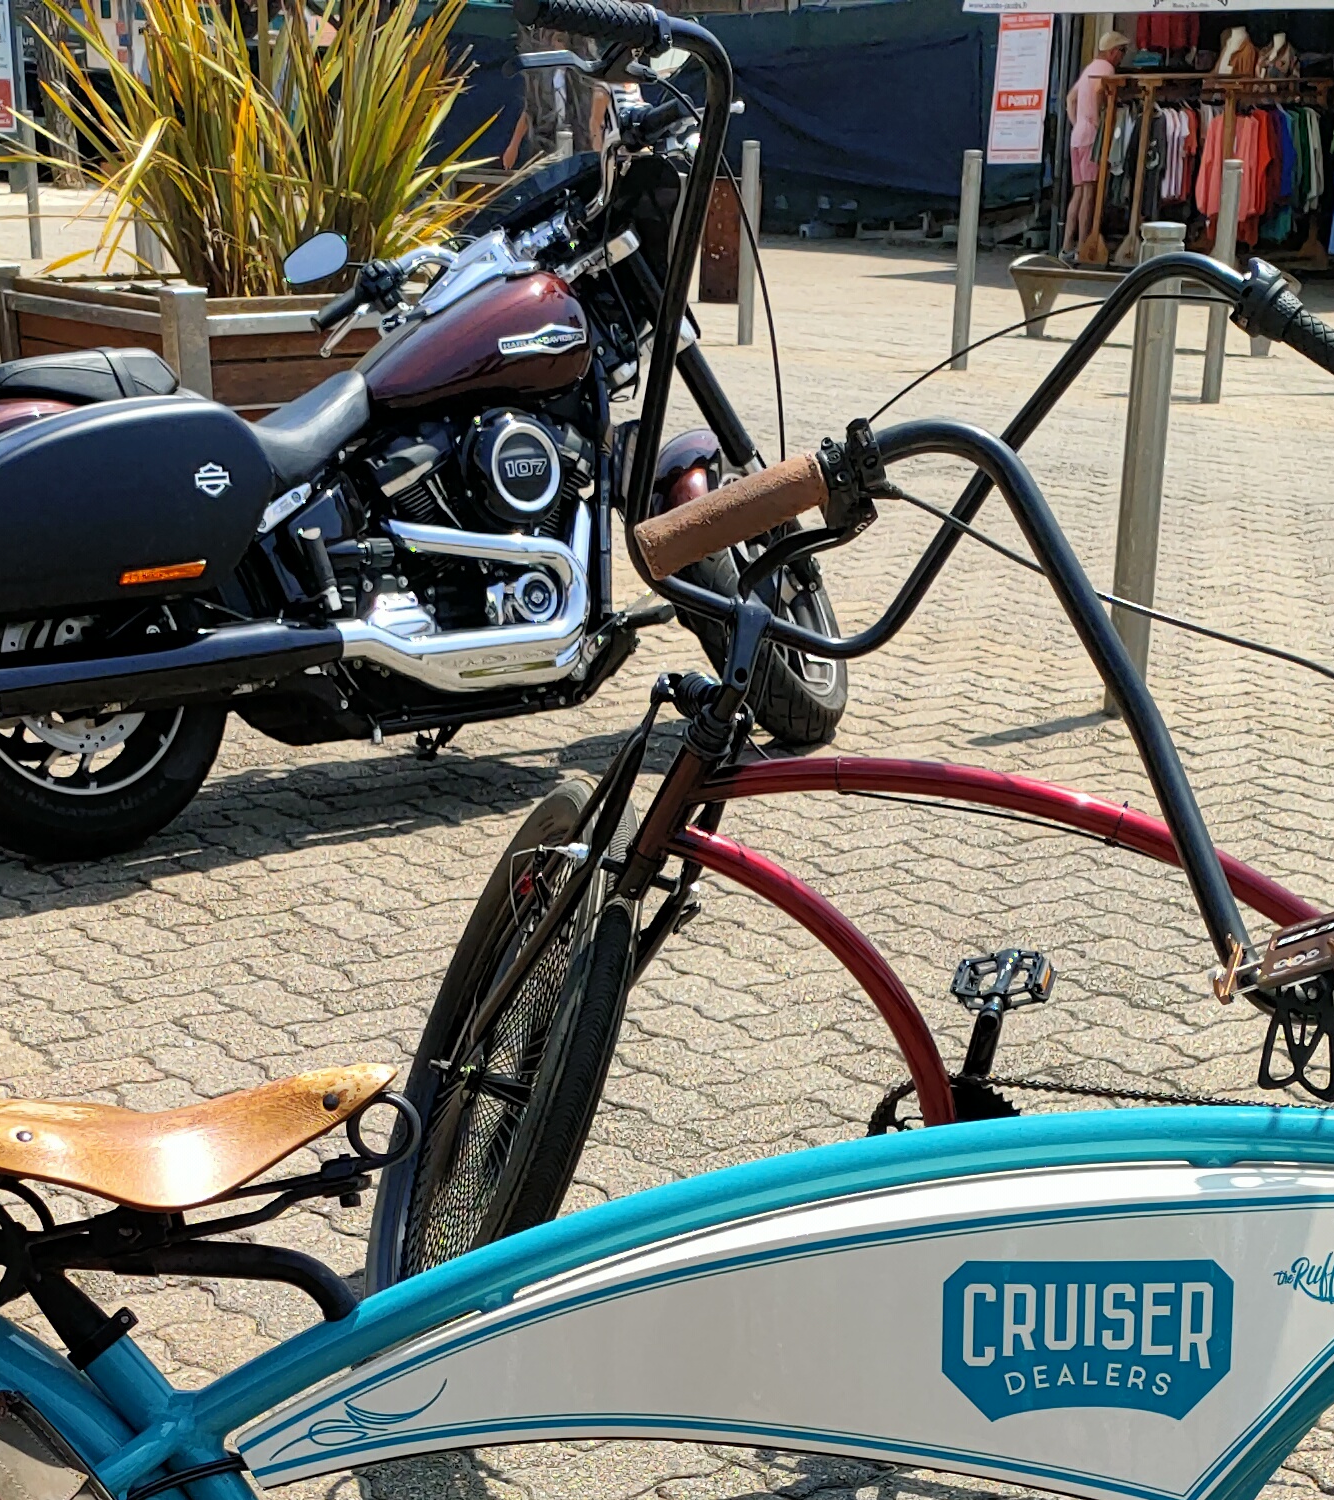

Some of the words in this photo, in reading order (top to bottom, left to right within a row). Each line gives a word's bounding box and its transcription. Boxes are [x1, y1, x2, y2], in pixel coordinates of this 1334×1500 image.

[502, 332, 585, 350] HARLEY-DAVIDSON
[505, 458, 547, 478] 107
[962, 1282, 1213, 1369] CRUISER
[1003, 1363, 1172, 1396] DEALERS
